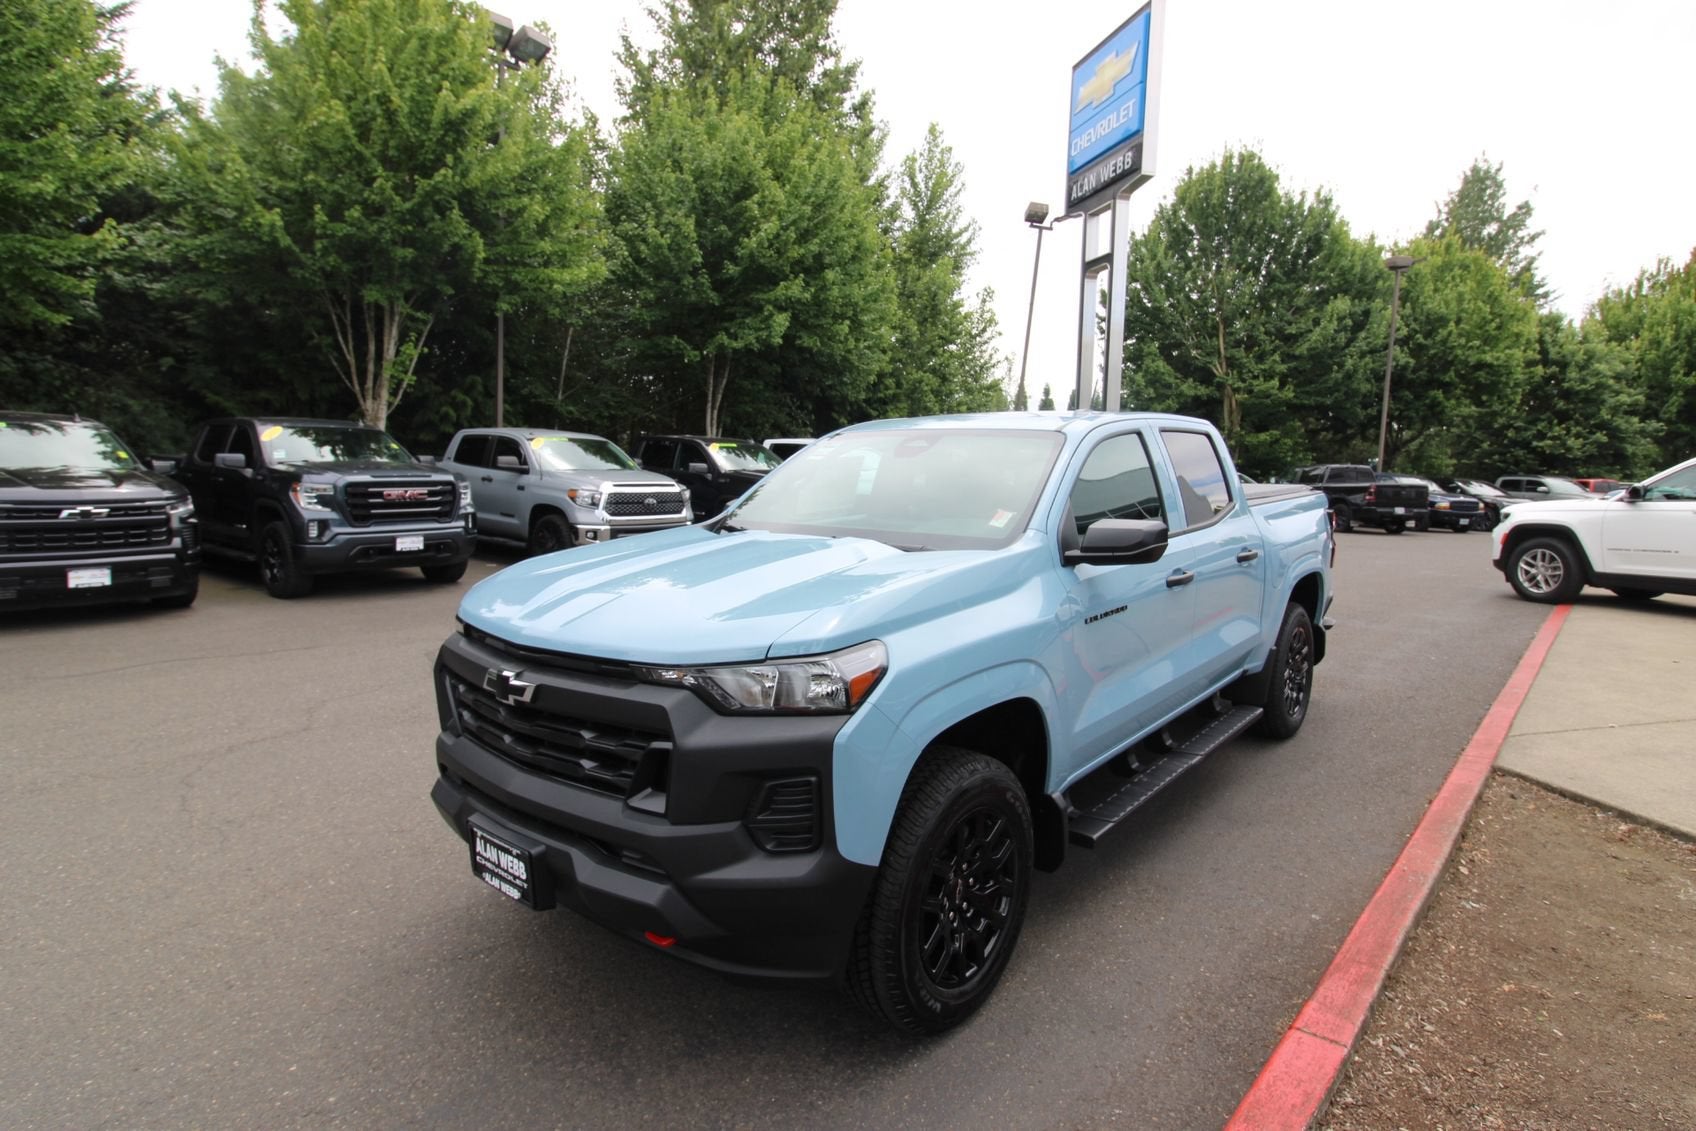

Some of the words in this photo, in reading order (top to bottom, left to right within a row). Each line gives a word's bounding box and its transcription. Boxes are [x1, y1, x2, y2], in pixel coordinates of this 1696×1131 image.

[1071, 99, 1136, 156] CHEVROLET
[1071, 174, 1097, 201] ALAN
[1099, 152, 1133, 183] WEBB
[476, 837, 499, 865] ALAN
[498, 849, 527, 880] WEBB
[476, 855, 528, 889] CHEVROLET
